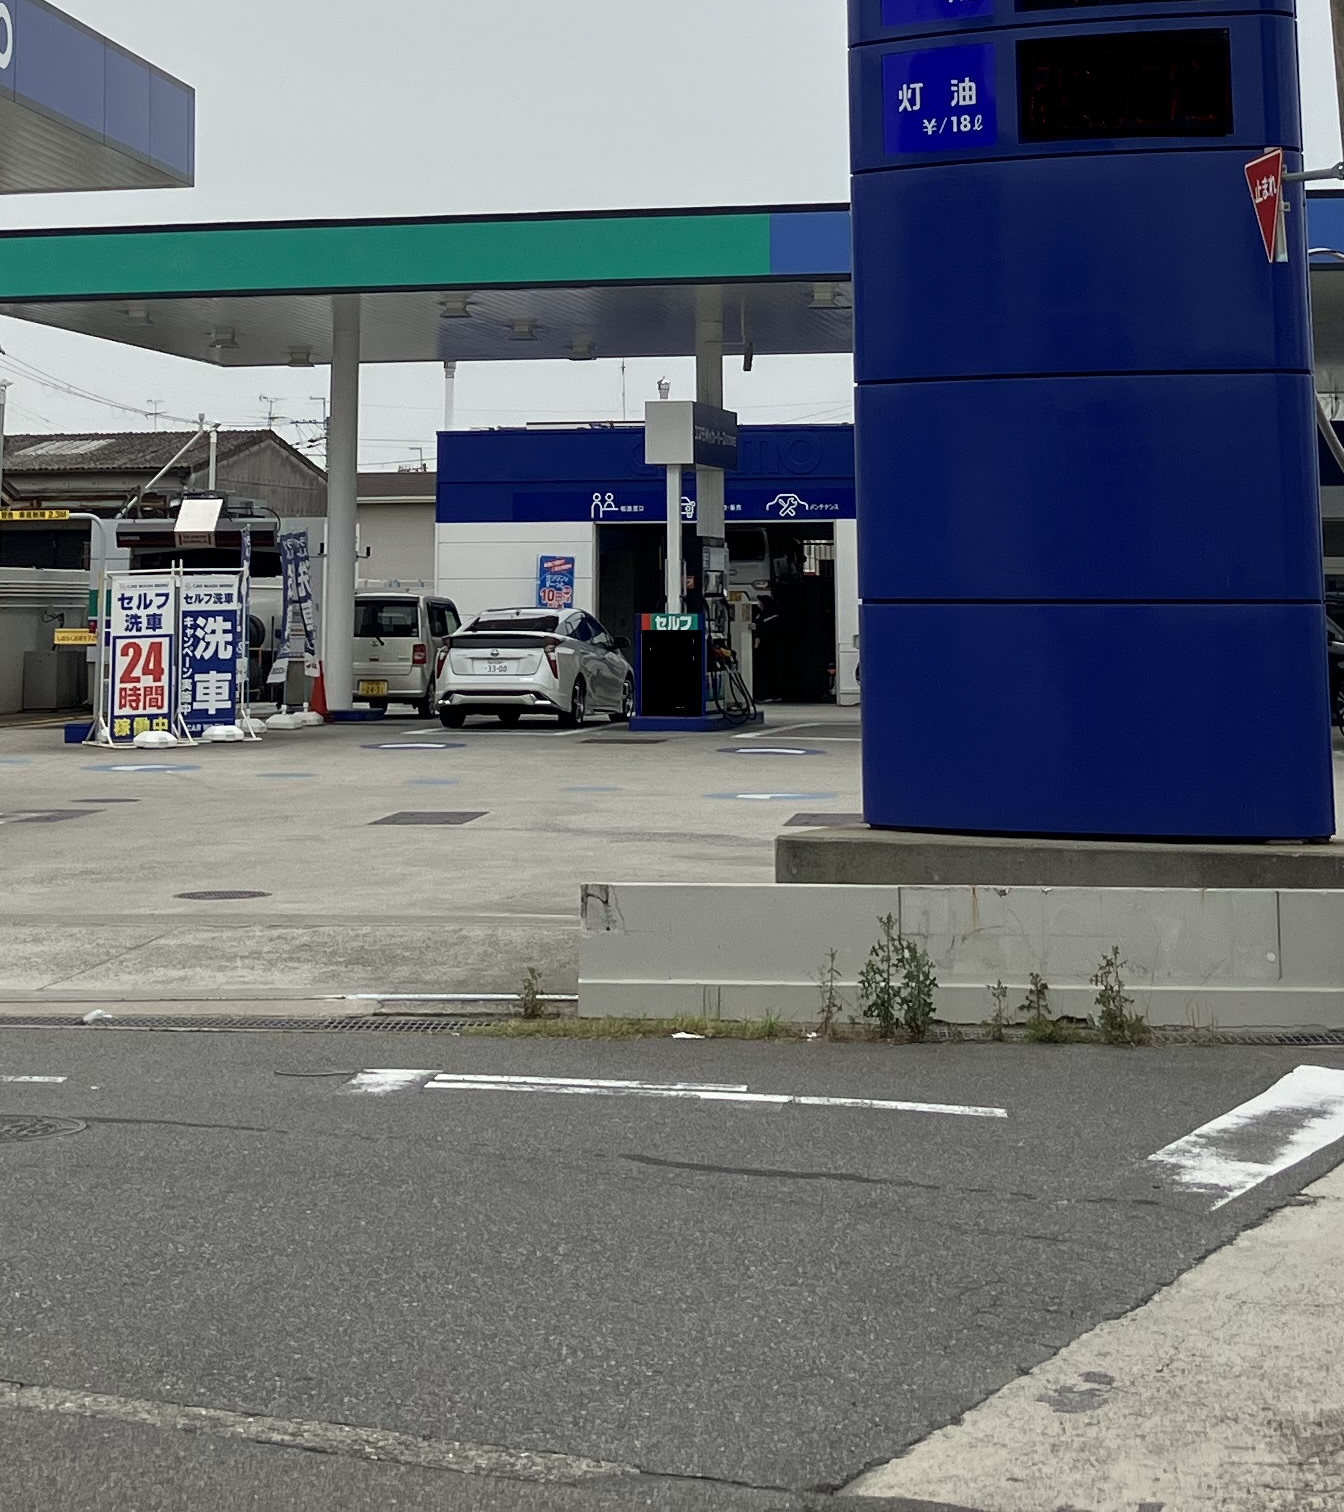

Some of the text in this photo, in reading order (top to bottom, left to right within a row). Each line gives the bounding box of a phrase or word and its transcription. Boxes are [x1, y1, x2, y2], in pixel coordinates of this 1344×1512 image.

[1255, 174, 1277, 203] 止まれ
[118, 592, 170, 610] セルフ
[184, 593, 234, 605] セルフ洗車
[125, 613, 163, 632] 洗車
[655, 615, 693, 630] セルフ
[119, 641, 164, 683] 24
[193, 616, 233, 714] 洗車
[119, 686, 165, 710] 時間
[114, 717, 168, 736] 稼働中
